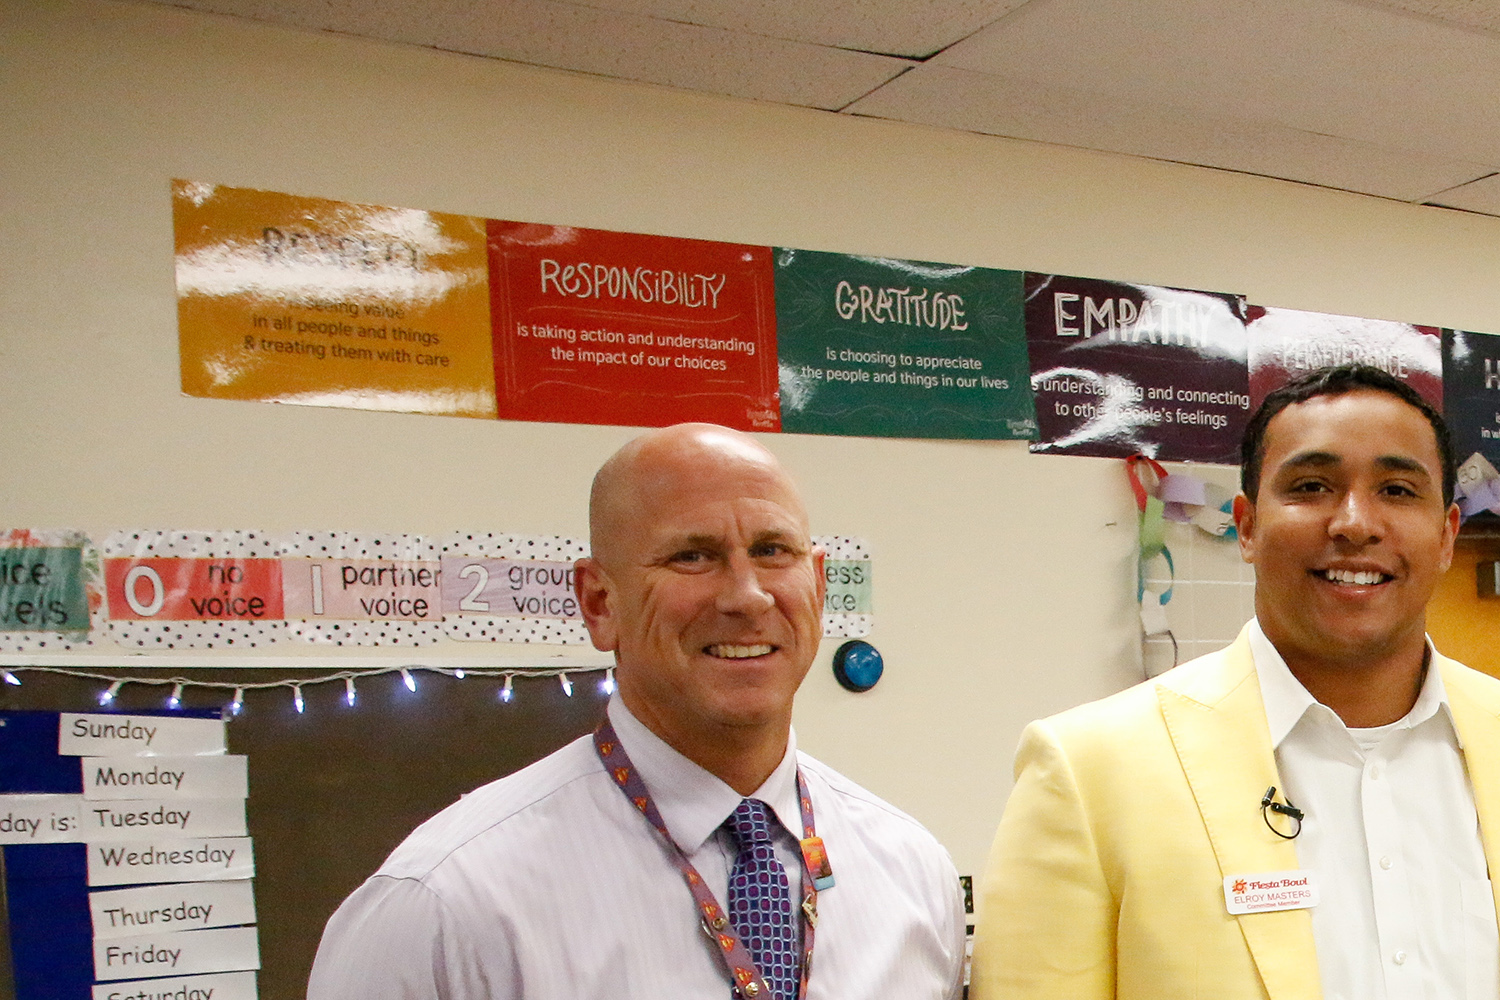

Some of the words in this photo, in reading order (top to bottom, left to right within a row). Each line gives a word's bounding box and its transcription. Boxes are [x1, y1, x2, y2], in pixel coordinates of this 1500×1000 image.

[363, 303, 404, 319] value
[835, 280, 968, 331] GRATITUDE
[254, 314, 267, 327] in
[273, 315, 292, 330] all
[297, 319, 351, 339] people
[358, 323, 387, 340] and
[392, 327, 440, 346] things
[1054, 292, 1217, 348] EMPATHY
[244, 335, 254, 350] &
[261, 338, 326, 360] treating
[331, 343, 372, 360] them
[377, 347, 410, 363] with
[416, 353, 450, 367] care
[518, 322, 528, 336] is
[532, 324, 576, 343] taking
[580, 328, 624, 344] action
[628, 330, 653, 346] and
[657, 333, 755, 355] understanding
[551, 347, 574, 362] the
[578, 348, 626, 366] impact
[630, 351, 644, 366] of
[648, 356, 670, 368] our
[674, 356, 726, 371] choices
[826, 347, 836, 360] is
[840, 349, 896, 368] choosing
[900, 354, 912, 366] to
[916, 356, 982, 370] appreciate
[801, 366, 822, 379] the
[826, 369, 869, 384] people
[873, 372, 896, 384] and
[900, 373, 938, 390] things
[942, 374, 953, 386] in
[956, 378, 976, 388] our
[981, 376, 1009, 390] lives
[1043, 380, 1144, 398] understanding
[1148, 386, 1173, 401] and
[1177, 388, 1250, 410] connecting
[1055, 401, 1069, 416] to
[1116, 406, 1172, 423] people's
[1176, 408, 1228, 430] feelings
[1482, 427, 1490, 438] in
[0, 561, 51, 586] ice
[208, 564, 244, 584] no
[342, 564, 442, 590] partner
[508, 564, 575, 590] group
[826, 566, 864, 584] ess
[124, 565, 164, 618] 0
[459, 563, 490, 613] 2
[826, 588, 856, 612] ice
[190, 590, 265, 617] voice
[360, 592, 428, 618] voice
[514, 591, 578, 615] voice
[72, 718, 157, 746] Sunday
[96, 766, 185, 790] Monday
[0, 814, 40, 838] day
[50, 812, 77, 833] is:
[93, 806, 191, 829] Tuesday
[100, 843, 236, 868] Wednesday
[1250, 880, 1280, 890] Fiesta
[1280, 878, 1308, 888] Bowl
[1234, 894, 1265, 904] ELROY
[1268, 890, 1312, 900] MASTERS
[1247, 902, 1276, 910] Committee
[1278, 900, 1300, 908] Member
[104, 902, 214, 928] Thursday
[106, 944, 181, 968] Friday
